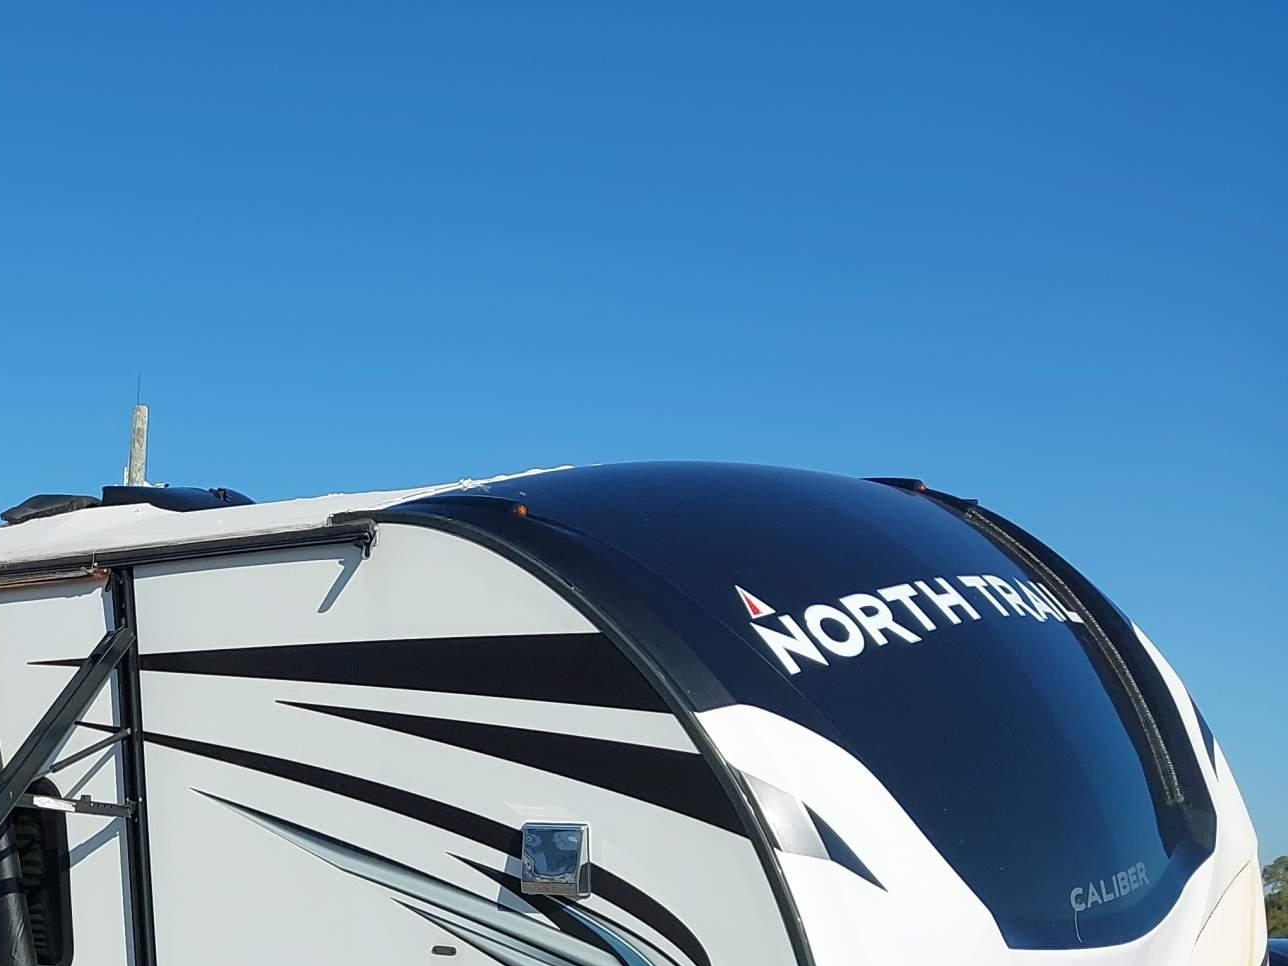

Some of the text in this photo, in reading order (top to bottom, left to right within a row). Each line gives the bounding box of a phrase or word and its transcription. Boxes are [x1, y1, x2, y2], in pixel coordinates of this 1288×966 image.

[749, 574, 1085, 675] NORTH TRAIL
[1070, 861, 1150, 912] CALIBER
